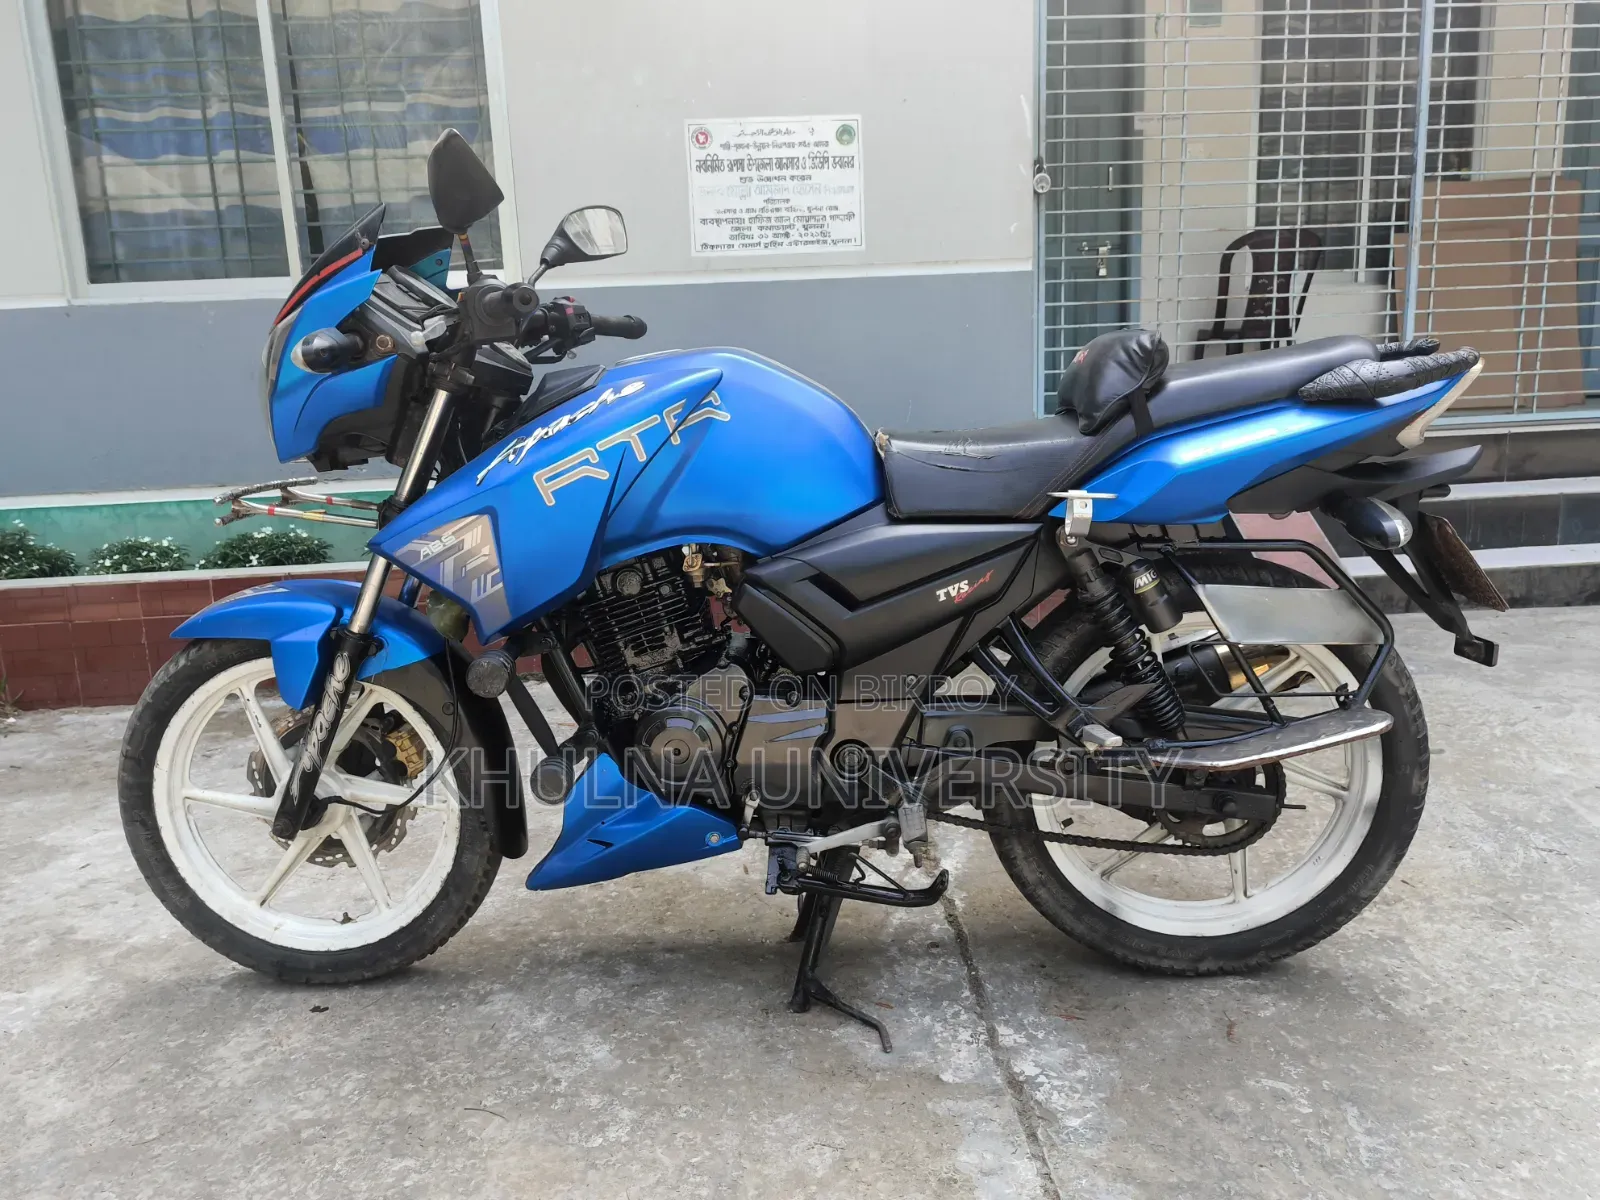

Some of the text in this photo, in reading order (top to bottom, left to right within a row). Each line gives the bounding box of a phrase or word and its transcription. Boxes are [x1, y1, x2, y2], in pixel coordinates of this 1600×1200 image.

[775, 156, 800, 171] আনসার
[801, 156, 807, 170] ও
[830, 155, 855, 170] ভবনের
[533, 390, 731, 506] RTR
[420, 532, 456, 560] ABS
[935, 579, 969, 602] TVS
